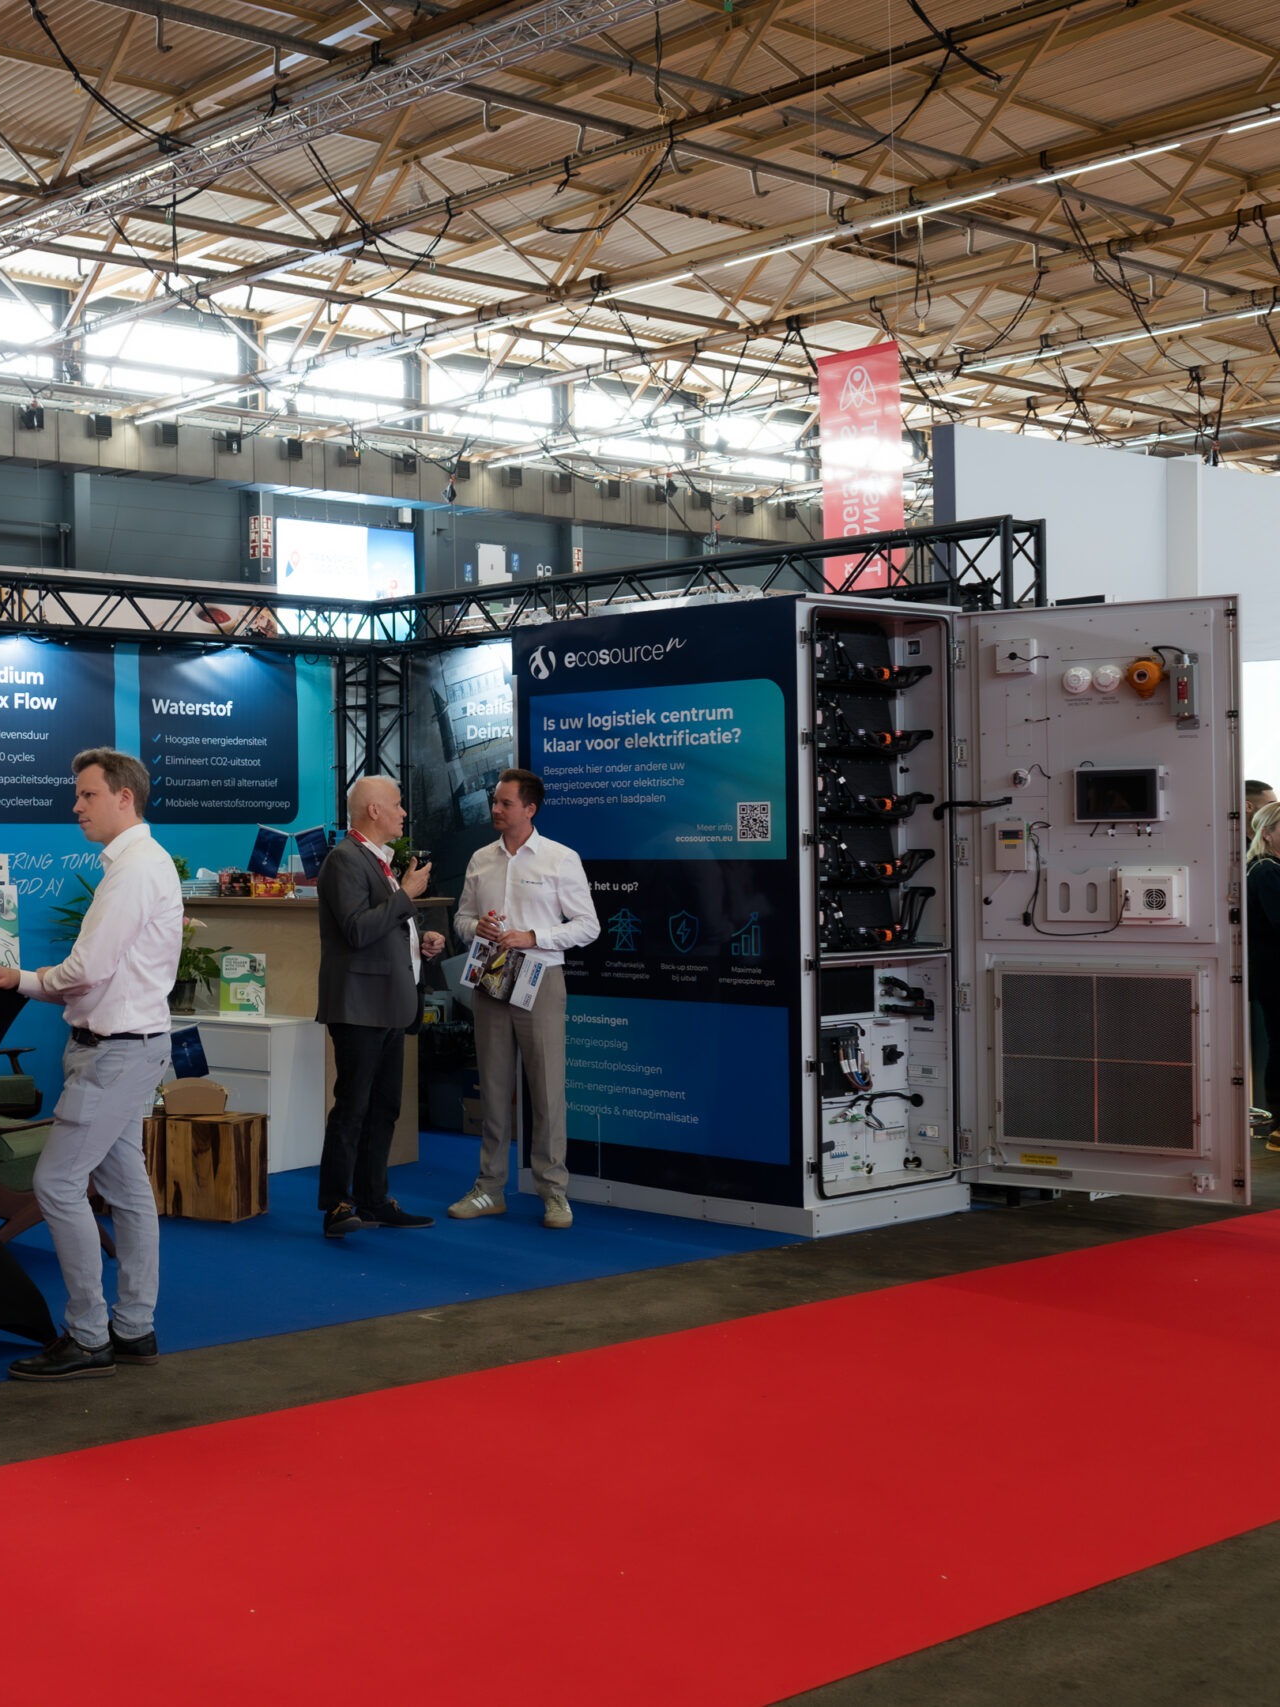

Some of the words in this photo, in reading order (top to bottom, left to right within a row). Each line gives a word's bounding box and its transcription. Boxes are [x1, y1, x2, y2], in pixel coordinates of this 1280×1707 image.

[14, 692, 58, 711] Flow
[152, 698, 234, 717] Waterstof
[543, 717, 556, 731] Is
[559, 717, 583, 730] uw
[587, 709, 656, 731] logistiek
[660, 706, 734, 724] centrum
[165, 735, 200, 746] Hoogste
[201, 736, 268, 747] energiedensiteit
[543, 737, 582, 753] klaar
[585, 737, 620, 750] voor
[624, 728, 742, 750] elektrificatie?
[7, 752, 36, 764] cycles
[165, 755, 209, 766] Elimineert
[210, 756, 261, 767] CO2-uitstoot
[543, 765, 584, 777] Bespreek
[586, 764, 603, 774] hier
[605, 763, 632, 773] onder
[634, 761, 668, 772] andere
[670, 762, 685, 771] uw
[165, 776, 209, 787] Duurzaam
[211, 779, 222, 787] en
[223, 777, 236, 787] stil
[237, 777, 278, 788] alternatief
[544, 780, 609, 792] energietoevoer
[611, 779, 631, 788] voor
[633, 776, 685, 787] elektrische
[165, 798, 199, 808] Mobiele
[200, 798, 290, 810] waterstofstroomgroep
[544, 795, 605, 806] vrachtwagens
[606, 796, 619, 804] en
[621, 793, 666, 804] laadpalen
[675, 834, 733, 843] ecosourcen.eu
[61, 852, 103, 871] TOMO
[15, 877, 65, 899] ODAY
[595, 881, 611, 891] het
[612, 883, 619, 891] u
[620, 881, 639, 893] op?
[572, 1012, 629, 1027] oplossingen
[565, 1035, 629, 1051] Energieopslag
[565, 1058, 663, 1076] Waterstofoplossingen
[565, 1079, 686, 1100] Slim-energiemanagement
[565, 1101, 612, 1116] Microgrids
[614, 1107, 621, 1116] &
[622, 1107, 700, 1124] netoptimalisatie
